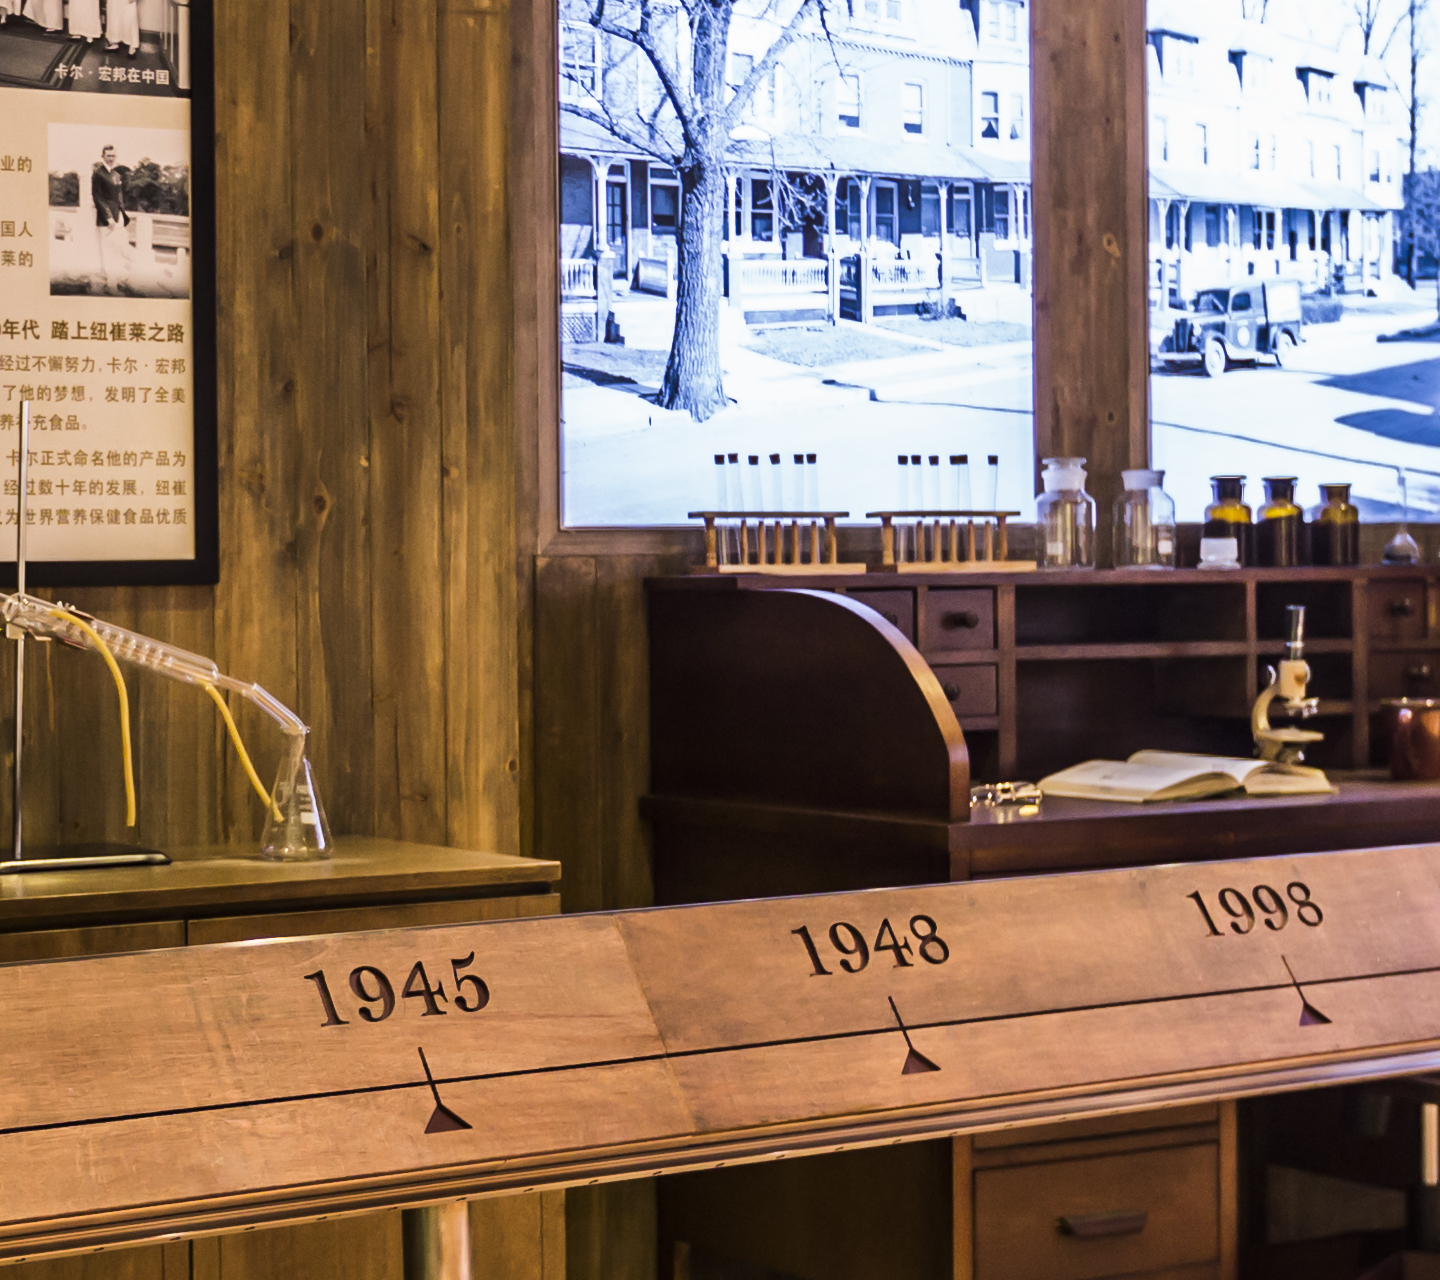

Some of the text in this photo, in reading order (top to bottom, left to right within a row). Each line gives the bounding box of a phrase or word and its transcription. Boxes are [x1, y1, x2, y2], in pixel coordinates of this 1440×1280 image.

[51, 321, 185, 344] 踏上纽崔莱之路
[1185, 880, 1324, 940] 1998
[790, 914, 951, 979] 1948
[303, 950, 492, 1029] 1945
